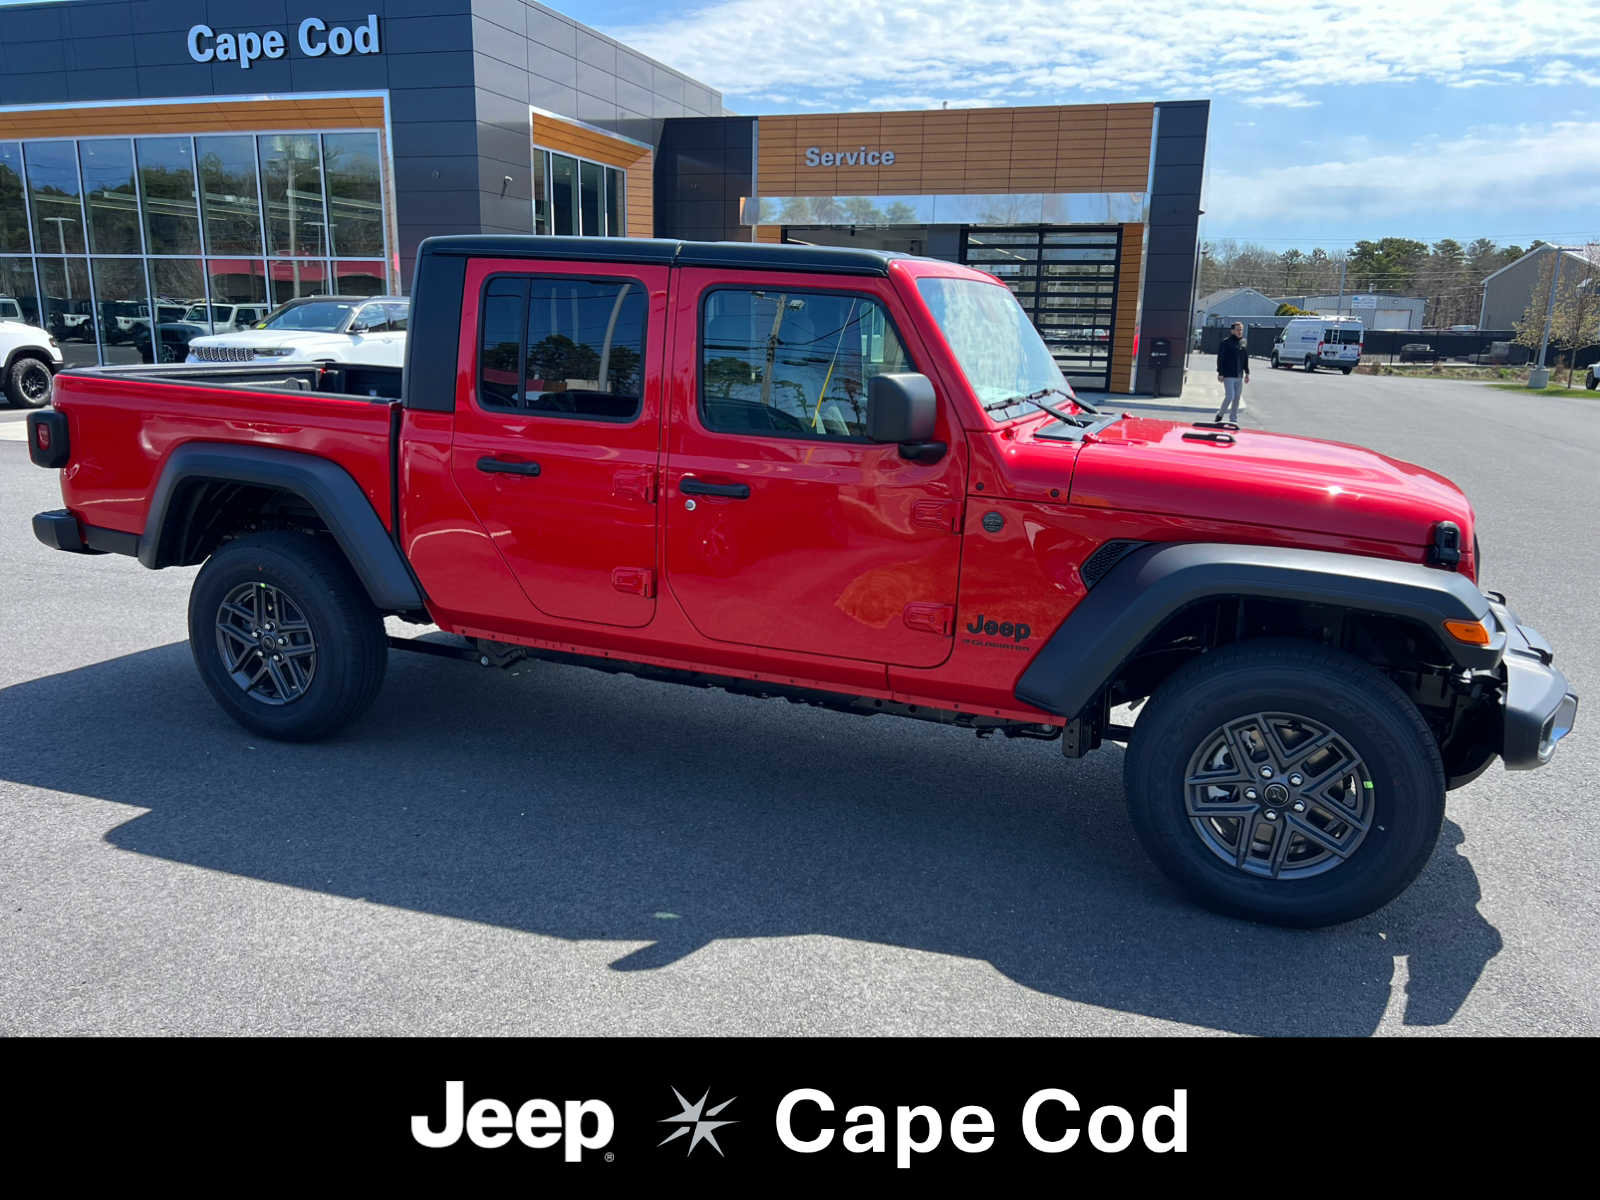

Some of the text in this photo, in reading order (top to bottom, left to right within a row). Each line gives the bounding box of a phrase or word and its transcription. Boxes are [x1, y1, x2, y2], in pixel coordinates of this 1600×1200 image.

[187, 14, 380, 69] Cape Cod
[804, 146, 896, 167] Service
[967, 614, 1032, 642] Jeep
